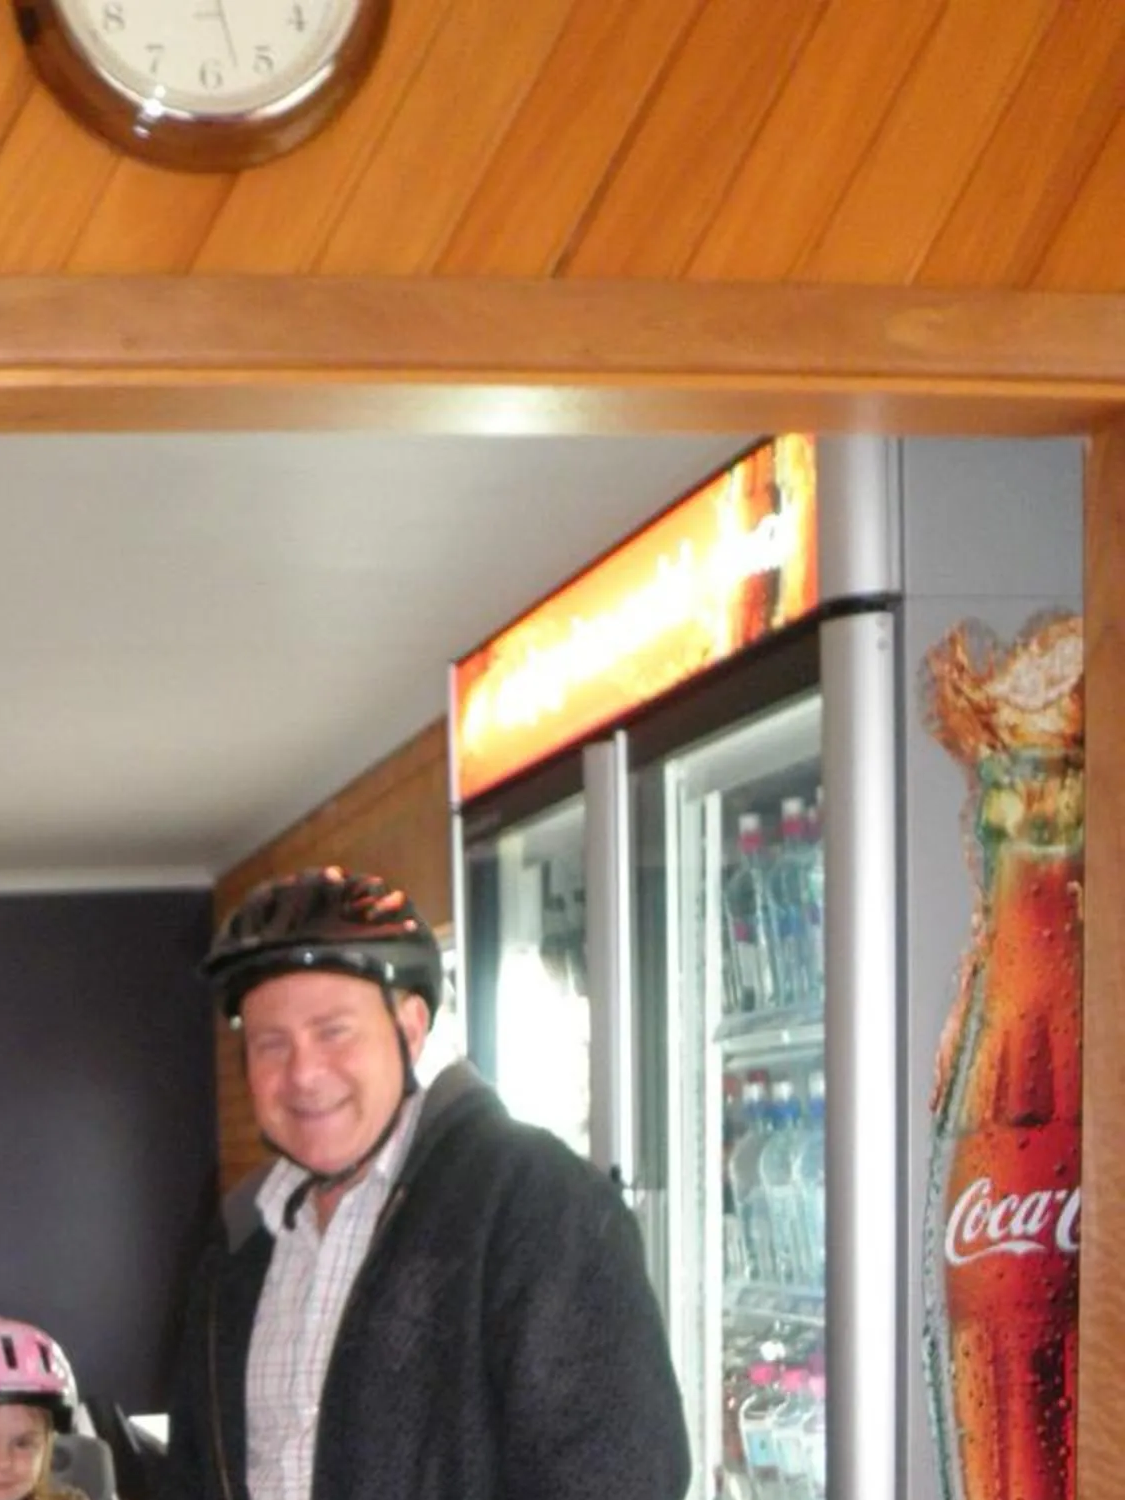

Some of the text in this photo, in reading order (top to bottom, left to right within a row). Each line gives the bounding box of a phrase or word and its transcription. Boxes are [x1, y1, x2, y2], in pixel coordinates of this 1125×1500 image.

[285, 4, 307, 33] 4
[145, 44, 165, 74] 7
[199, 57, 223, 90] 6
[252, 45, 274, 73] 5
